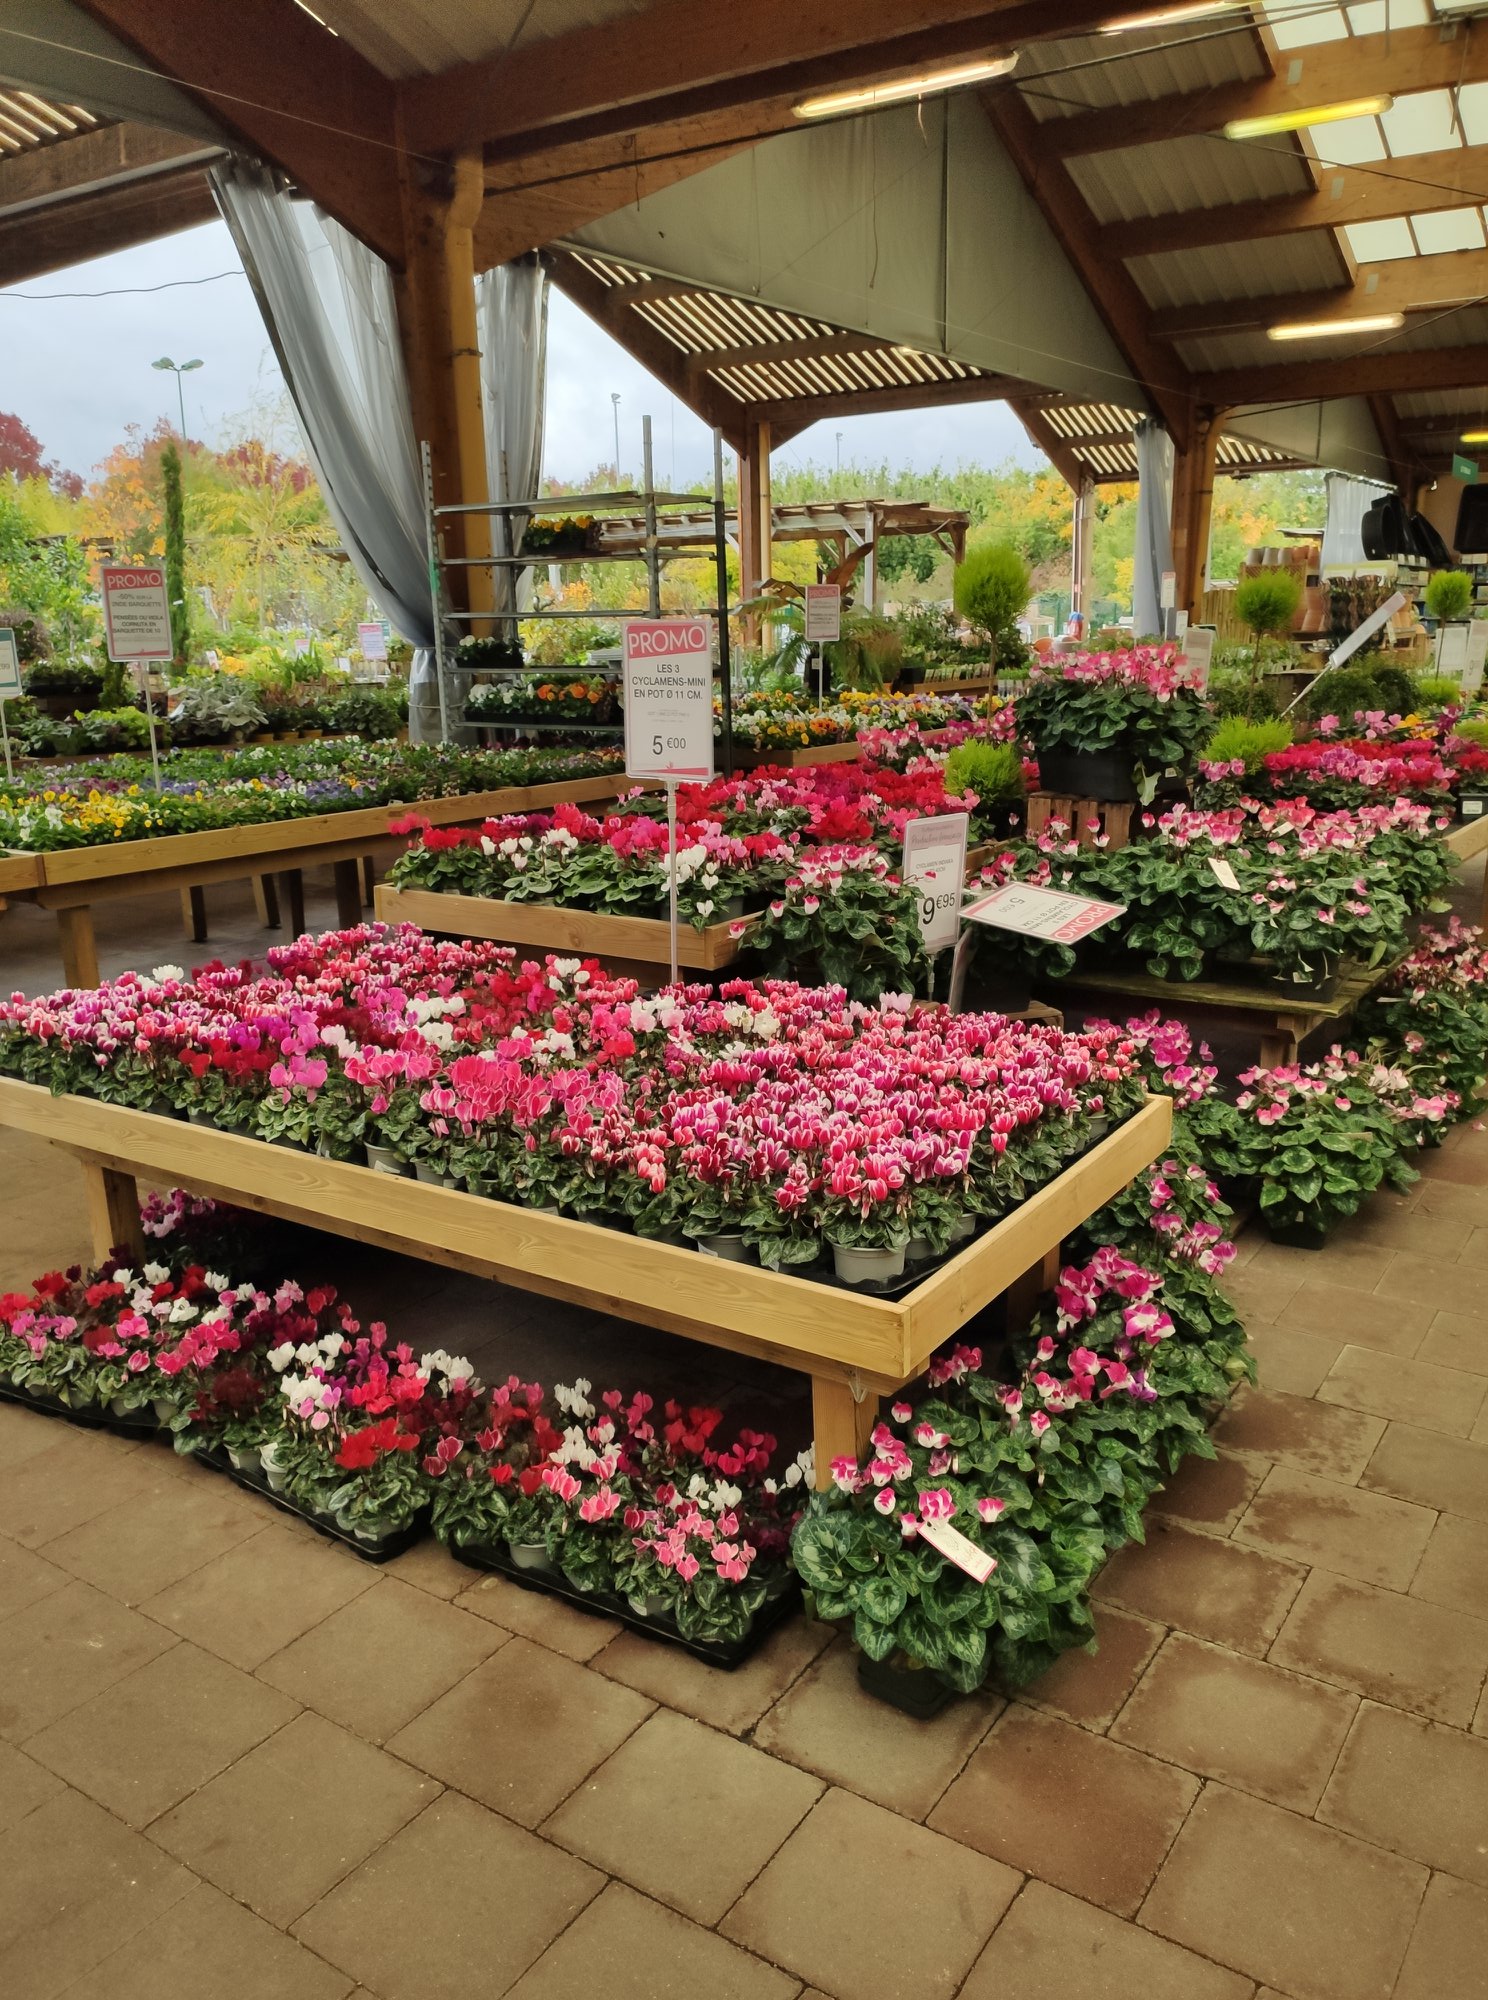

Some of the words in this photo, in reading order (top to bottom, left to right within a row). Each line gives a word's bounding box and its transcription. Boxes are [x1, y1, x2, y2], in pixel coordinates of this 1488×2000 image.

[107, 572, 161, 588] PROMO
[628, 625, 706, 655] PROMO
[657, 664, 673, 673] LES
[674, 664, 680, 673] 3
[632, 676, 706, 687] CYCLAMENS-MINI
[634, 688, 646, 698] EN
[647, 689, 665, 699] POT
[675, 690, 684, 699] 11
[686, 690, 703, 700] CM.
[652, 735, 663, 755] 5
[666, 737, 687, 749] €00
[922, 896, 935, 925] 9
[936, 892, 955, 909] €95
[1054, 905, 1111, 939] PROMO
